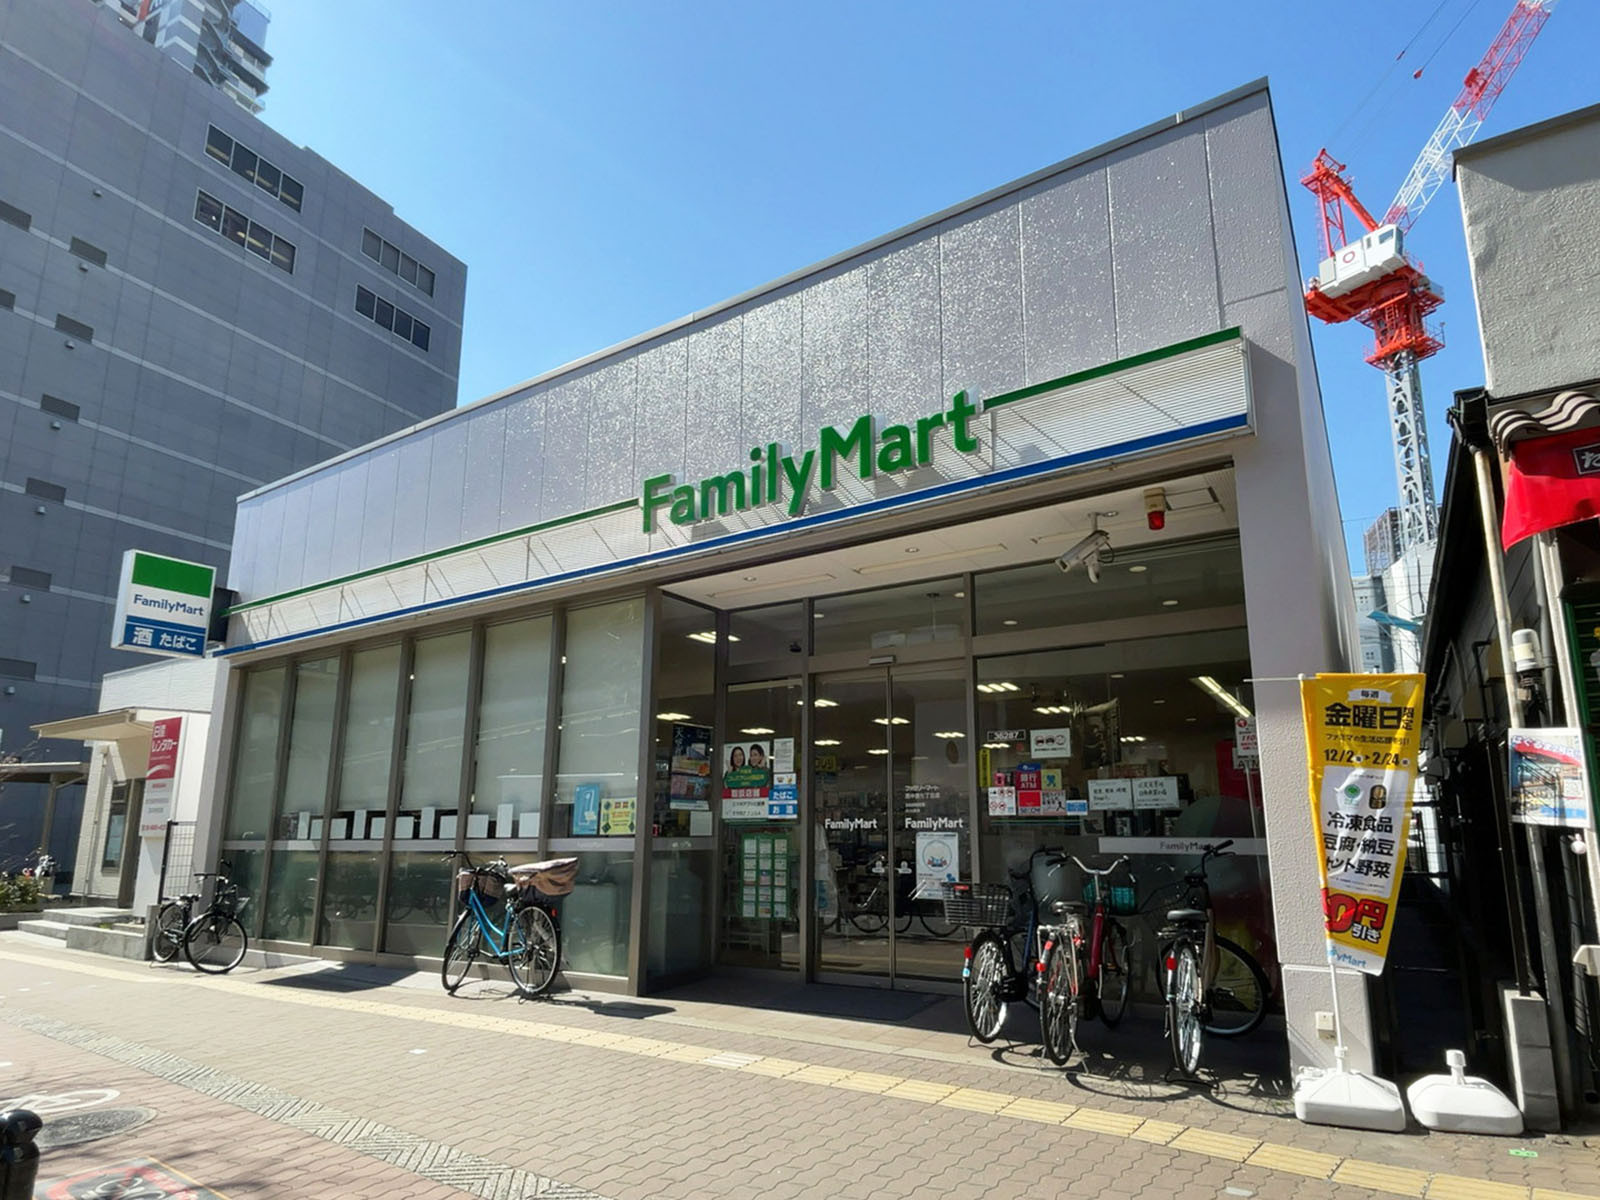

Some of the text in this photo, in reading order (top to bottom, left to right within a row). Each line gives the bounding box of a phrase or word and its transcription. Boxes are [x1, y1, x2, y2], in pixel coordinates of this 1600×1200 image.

[641, 389, 980, 534] FamilyMart
[133, 593, 204, 616] FamilyMart
[133, 627, 197, 650] 酒 たばこ
[1361, 690, 1379, 698] 毎週
[1325, 702, 1402, 729] 金曜日
[1324, 749, 1354, 763] 12/2
[1372, 752, 1400, 766] 2/24
[825, 818, 877, 831] FamilyMart
[905, 817, 963, 831] FamilyMart
[1327, 811, 1393, 833] 冷凍食品
[1159, 840, 1212, 853] FamilyMa
[1322, 833, 1395, 857] 豆腐・納豆
[1352, 923, 1381, 943] 引き
